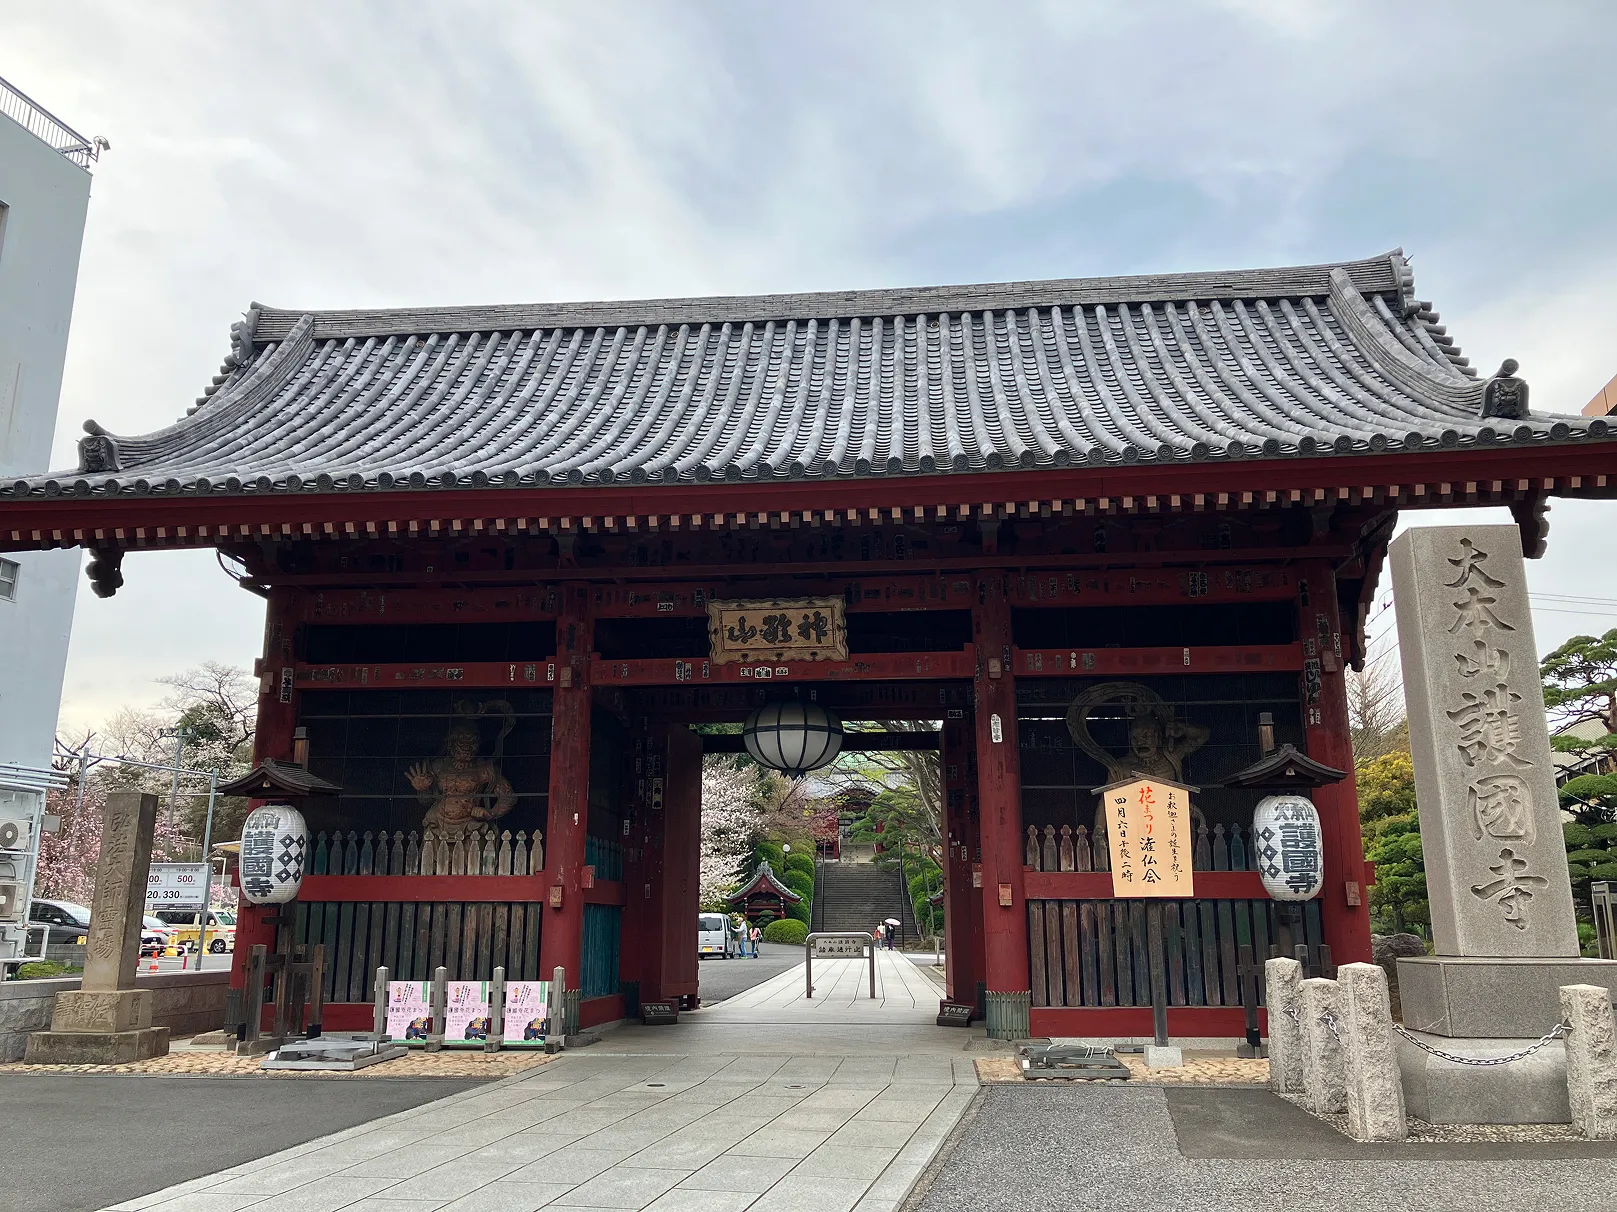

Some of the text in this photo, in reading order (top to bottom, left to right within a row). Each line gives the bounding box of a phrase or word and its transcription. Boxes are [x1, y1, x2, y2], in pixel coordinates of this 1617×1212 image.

[1114, 797, 1134, 883] 四月六日午後二時
[1443, 537, 1549, 930] 大本山護國寺
